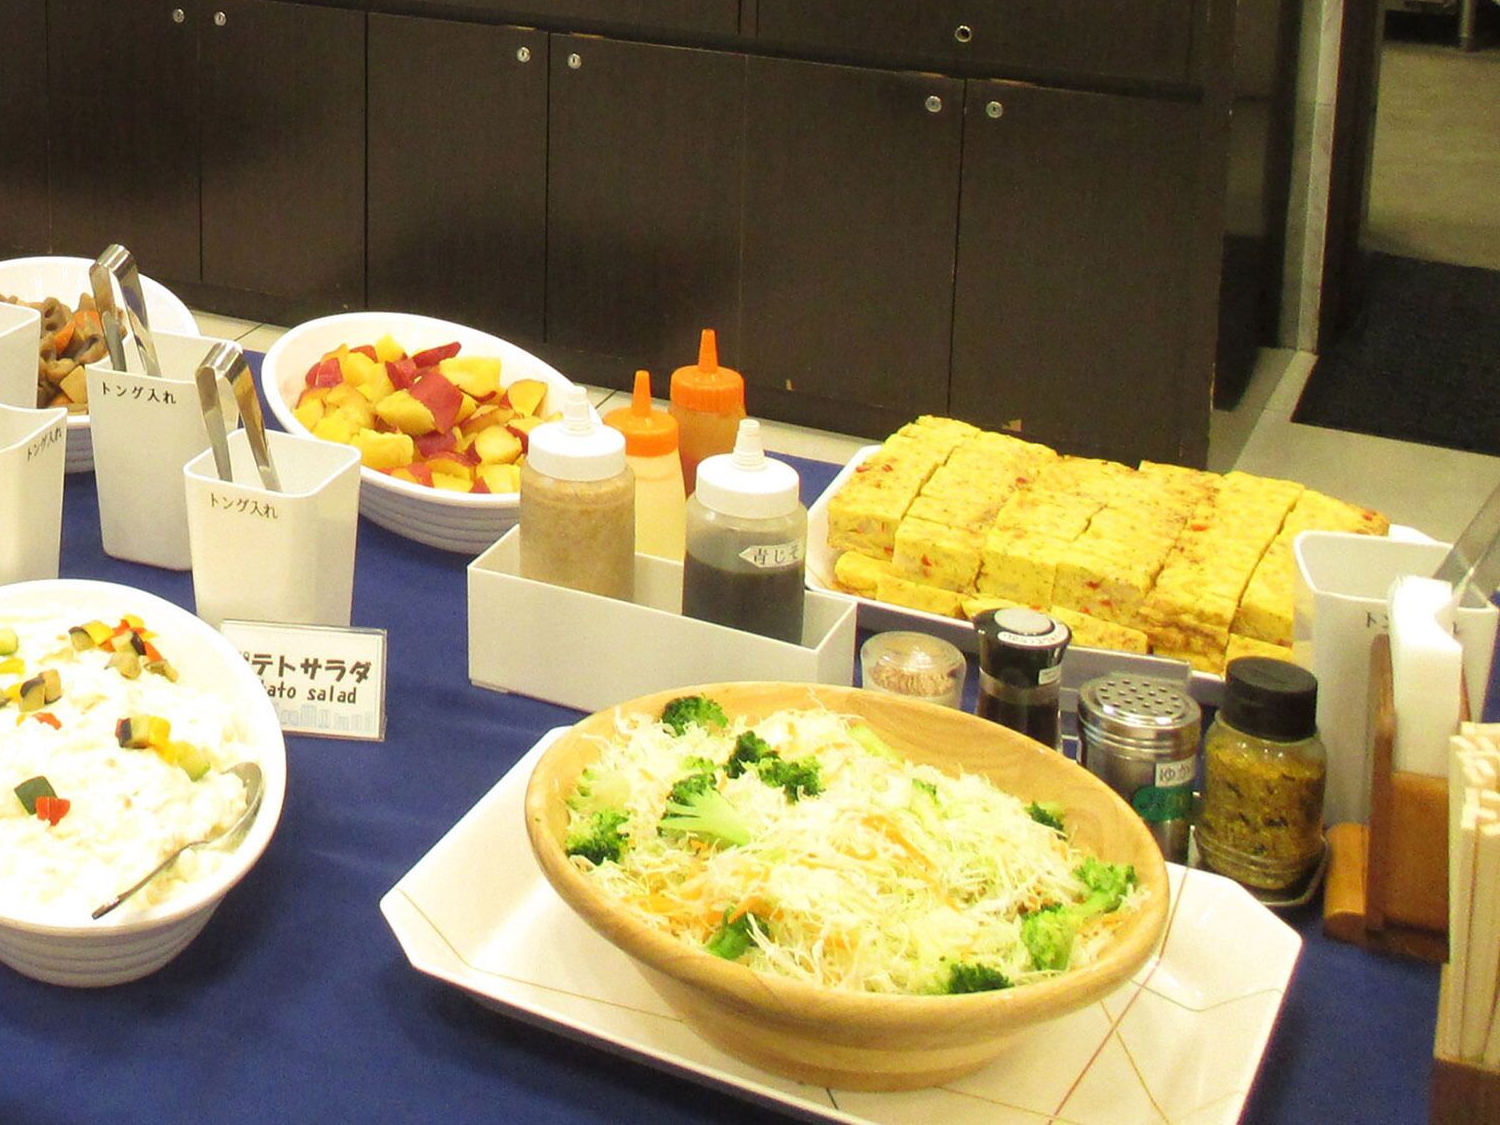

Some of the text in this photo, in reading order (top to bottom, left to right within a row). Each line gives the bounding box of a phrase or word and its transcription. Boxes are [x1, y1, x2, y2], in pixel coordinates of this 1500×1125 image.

[101, 382, 177, 406] トング入れ
[25, 426, 62, 462] トング入れ
[209, 492, 278, 520] トング入れ
[307, 685, 357, 704] salad
